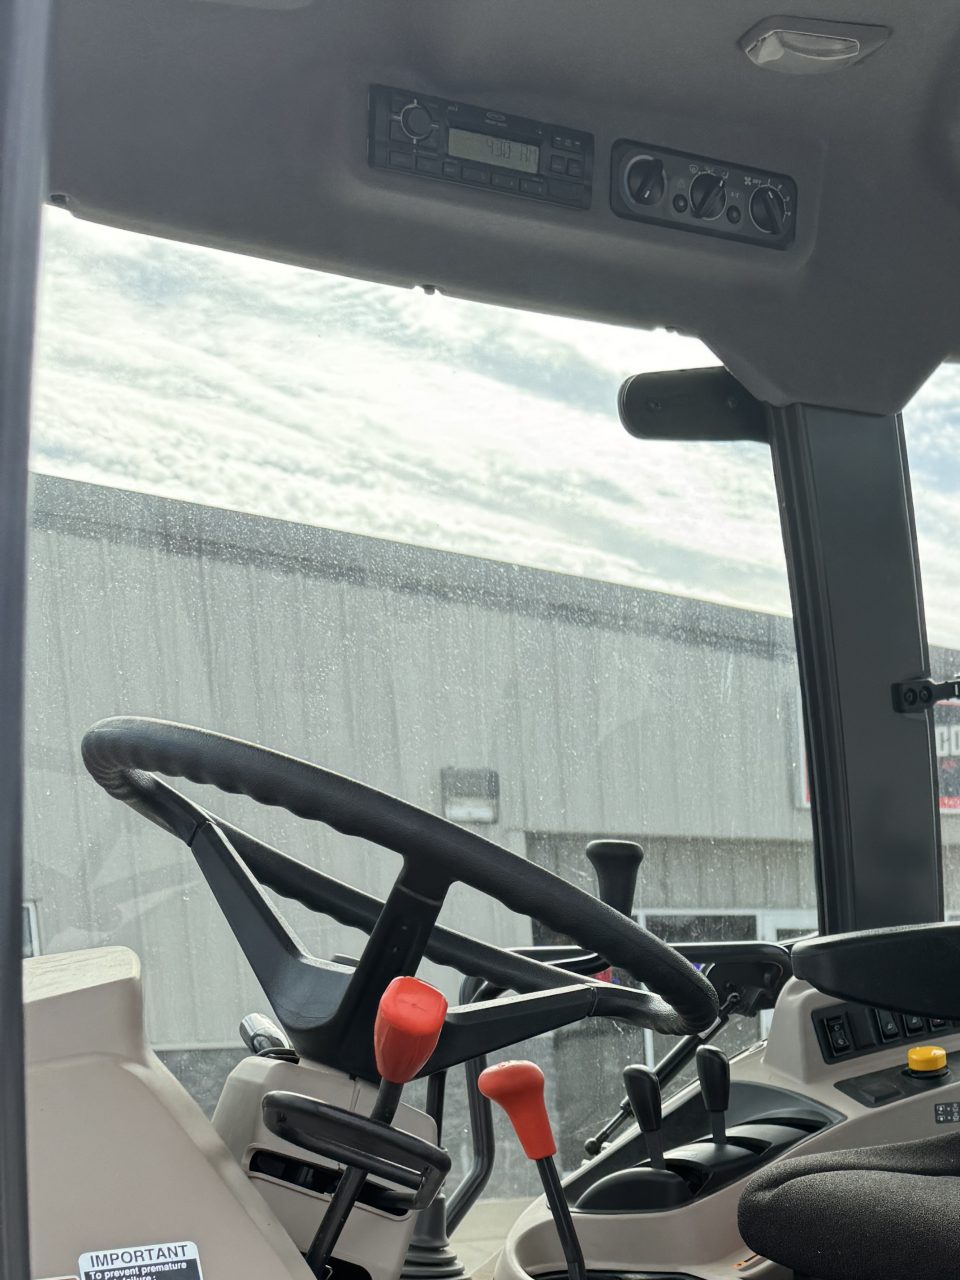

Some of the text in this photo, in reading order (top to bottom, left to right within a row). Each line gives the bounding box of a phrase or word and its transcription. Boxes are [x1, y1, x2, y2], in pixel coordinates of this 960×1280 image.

[90, 1245, 187, 1267] IMPORTANT
[89, 1262, 187, 1280] To prevent premature
